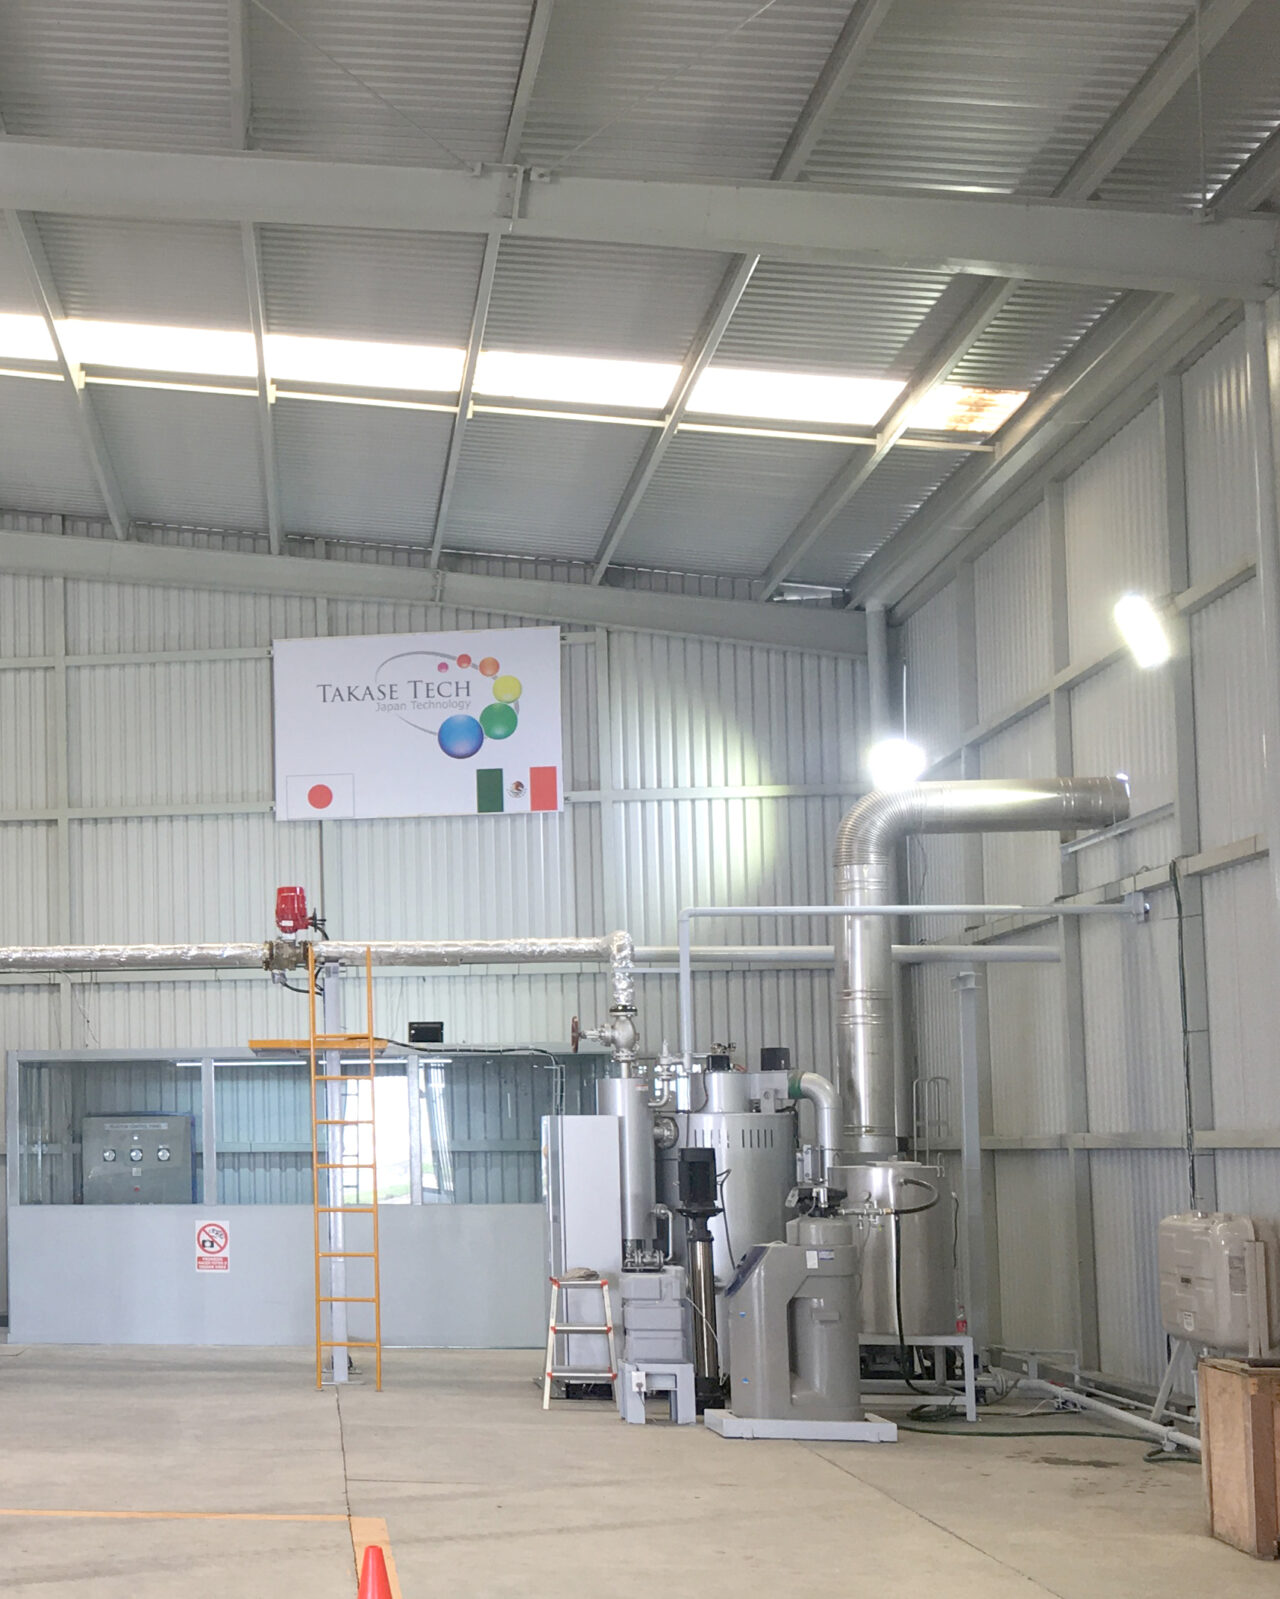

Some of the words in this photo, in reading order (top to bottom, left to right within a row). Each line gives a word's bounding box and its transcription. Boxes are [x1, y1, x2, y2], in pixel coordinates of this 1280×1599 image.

[317, 684, 398, 703] TAKASE
[408, 680, 471, 699] TECH
[376, 702, 407, 712] Japan
[412, 700, 471, 711] Technology
